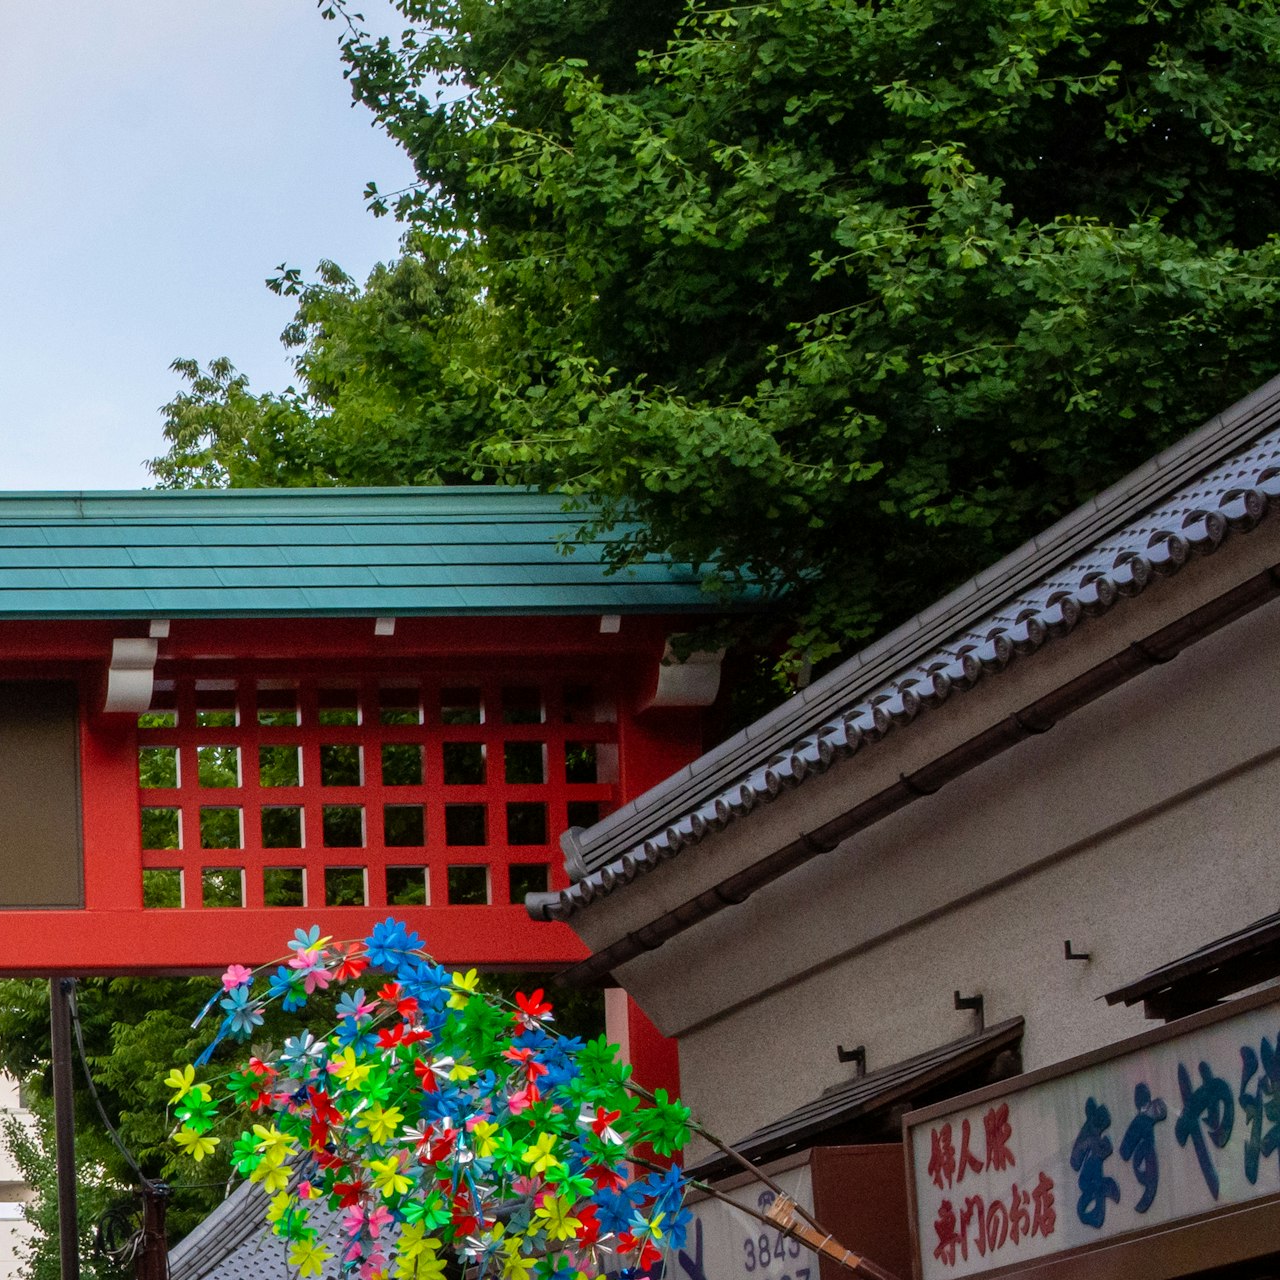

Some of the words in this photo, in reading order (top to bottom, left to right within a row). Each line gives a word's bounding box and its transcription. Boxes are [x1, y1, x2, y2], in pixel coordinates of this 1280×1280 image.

[928, 1102, 1016, 1191] 婦人服
[932, 1171, 1057, 1268] 専門のお店
